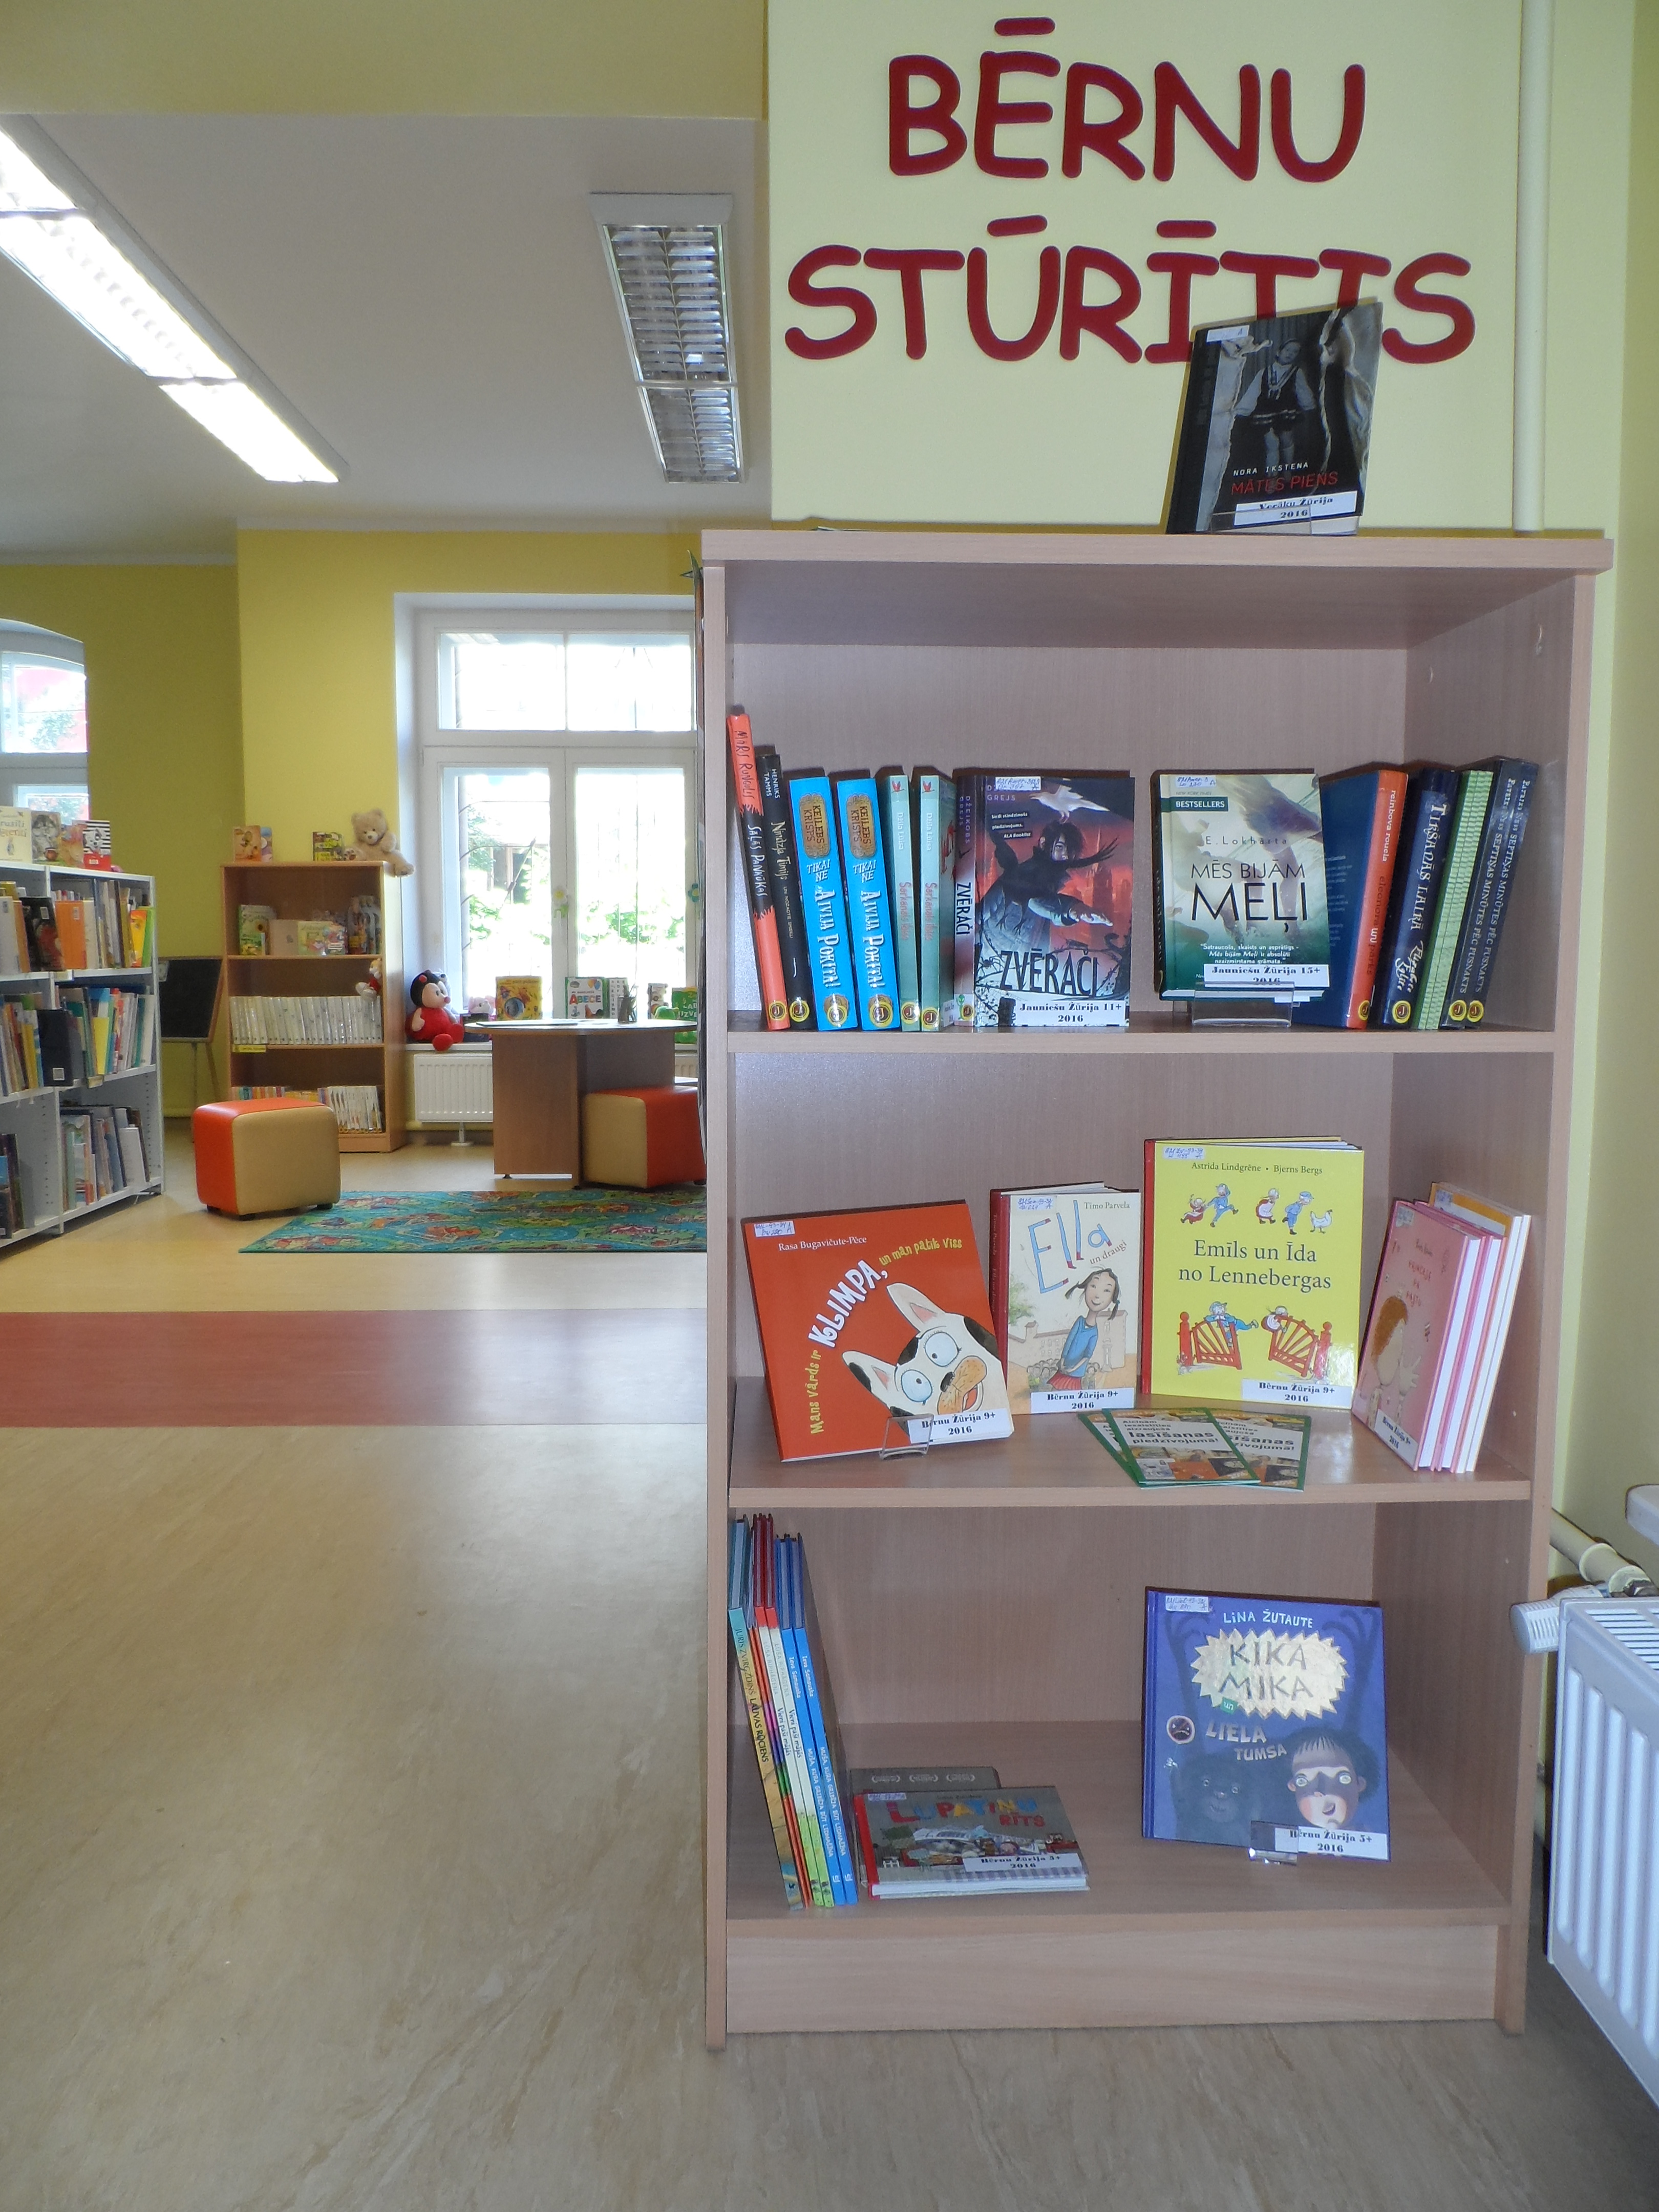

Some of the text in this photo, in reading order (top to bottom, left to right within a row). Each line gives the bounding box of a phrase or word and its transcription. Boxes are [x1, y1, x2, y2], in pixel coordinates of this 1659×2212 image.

[888, 16, 1367, 183] BĒRNU
[1233, 462, 1309, 477] NORA IKSTENA
[1231, 471, 1338, 496] MĀTES PIENS
[1280, 509, 1308, 519] 2016
[763, 772, 772, 797] TAMMS
[771, 769, 780, 799] HENRIKS
[803, 809, 815, 842] KRISPS
[812, 805, 825, 844] KEILEBS
[850, 809, 862, 842] KRISPS
[860, 805, 871, 844] KEILEBS
[1382, 790, 1396, 862] reinbova rouela
[1206, 836, 1218, 845] E.
[806, 859, 831, 874] TIKAI
[815, 870, 828, 882] NE
[853, 859, 877, 874] TIKAI
[861, 870, 874, 883] NE
[1191, 860, 1232, 879] MĒS
[1241, 859, 1305, 879] BIJĀM
[955, 882, 972, 935] ZVĒRAČI
[1191, 882, 1307, 933] MEĻI
[1475, 879, 1492, 925] MINŪTES
[1491, 879, 1507, 925] MINŪTES
[999, 948, 1100, 998] ZVĒRAČI
[1263, 965, 1296, 975] Žūrija
[1460, 947, 1477, 994] PUSNAKTS
[569, 993, 601, 1005] ABECE
[1019, 1001, 1122, 1013] Jauniešu Žūrija 11+
[1057, 1014, 1084, 1023] 2016
[1191, 1162, 1323, 1176] Astrida Lindgrēne Bjerns Bergs
[1105, 1201, 1131, 1209] Parvela
[879, 1254, 892, 1266] un
[892, 1246, 913, 1260] man
[943, 1238, 962, 1248] viss
[1028, 1200, 1113, 1294] Ella
[1089, 1239, 1128, 1265] un draugi
[1194, 1239, 1317, 1263] Emīls un Īda
[1178, 1265, 1332, 1293] no Lennebergas
[807, 1259, 888, 1349] KLIMPA,
[805, 1349, 824, 1435] Mans vārds ir
[1046, 1393, 1075, 1401] Bērnu
[1077, 1391, 1105, 1400] Žūrija
[1258, 1382, 1335, 1394] Bērnu Žūrija 9+
[1284, 1394, 1309, 1403] 2016
[1071, 1401, 1095, 1409] 2016
[952, 1414, 982, 1423] Žūrija
[948, 1426, 972, 1435] 2016
[1262, 1609, 1313, 1628] ŽUTAUTE
[734, 1628, 743, 1648] JURIS
[1229, 1640, 1307, 1671] KIKA
[1218, 1673, 1313, 1700] MIKA
[749, 1698, 769, 1763] LAUVAS RŪCIENS
[1205, 1721, 1267, 1743] LIELA
[1233, 1744, 1288, 1762] TUMSA
[1324, 1829, 1356, 1843] Žūrija
[1359, 1834, 1372, 1843] 5+
[1317, 1843, 1344, 1853] 2016
